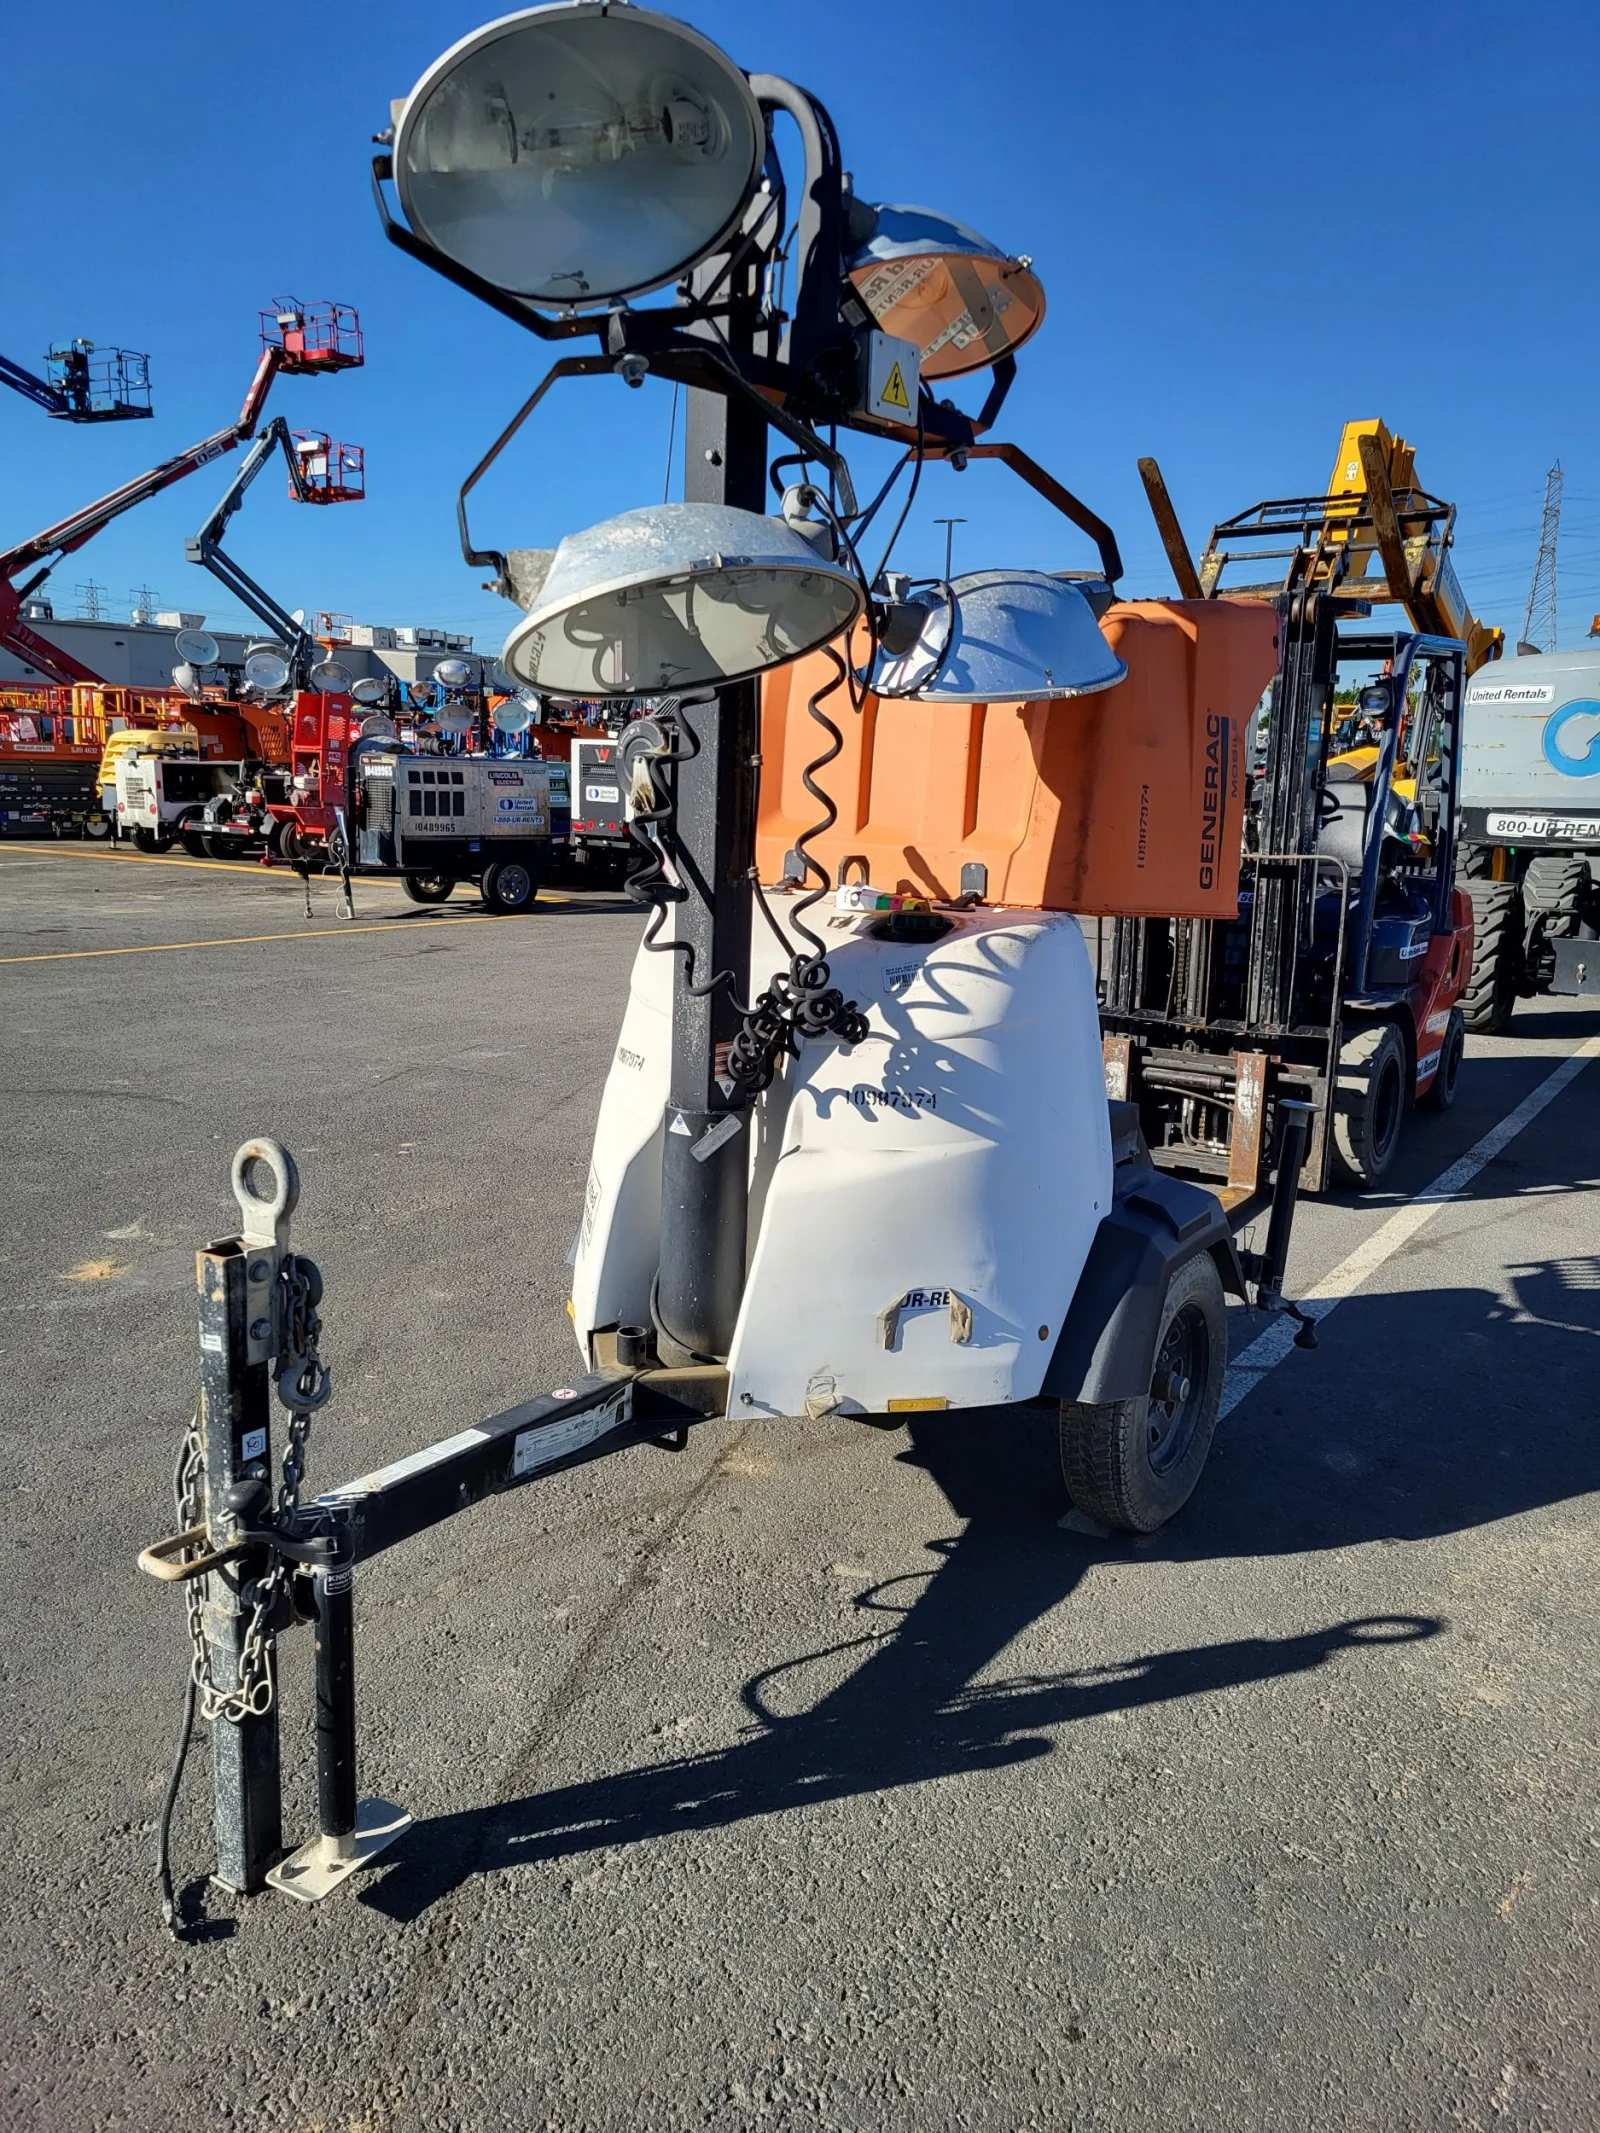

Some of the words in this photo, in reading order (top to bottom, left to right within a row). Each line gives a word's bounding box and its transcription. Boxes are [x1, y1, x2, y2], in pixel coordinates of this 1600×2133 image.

[1472, 690, 1502, 700] United
[1503, 688, 1547, 699] Rentals
[1200, 715, 1220, 889] GENERAC
[415, 822, 456, 832] 10489965
[1137, 784, 1150, 868] 10987974
[846, 1090, 936, 1109] 10987974
